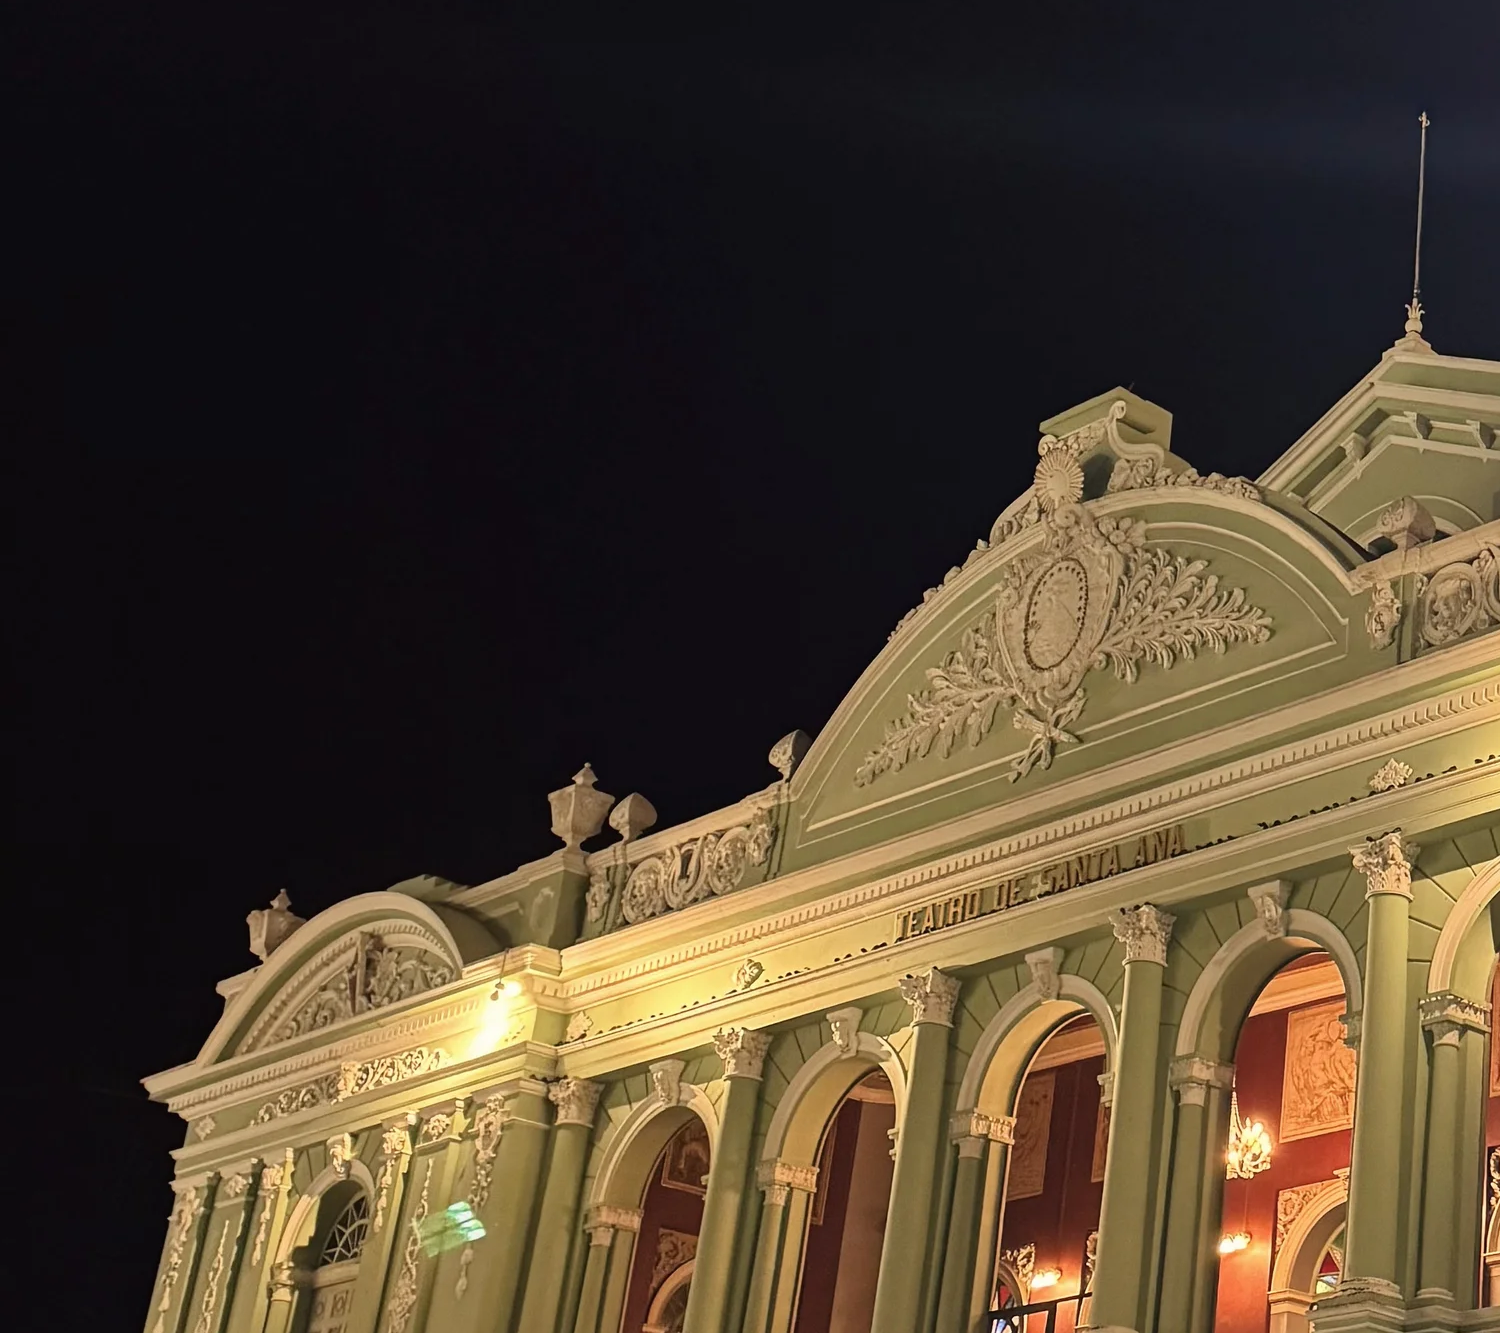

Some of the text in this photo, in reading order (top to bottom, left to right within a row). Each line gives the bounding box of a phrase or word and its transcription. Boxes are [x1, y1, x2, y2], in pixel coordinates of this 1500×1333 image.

[896, 824, 1185, 939] TEATRO DE SANTA ANA
